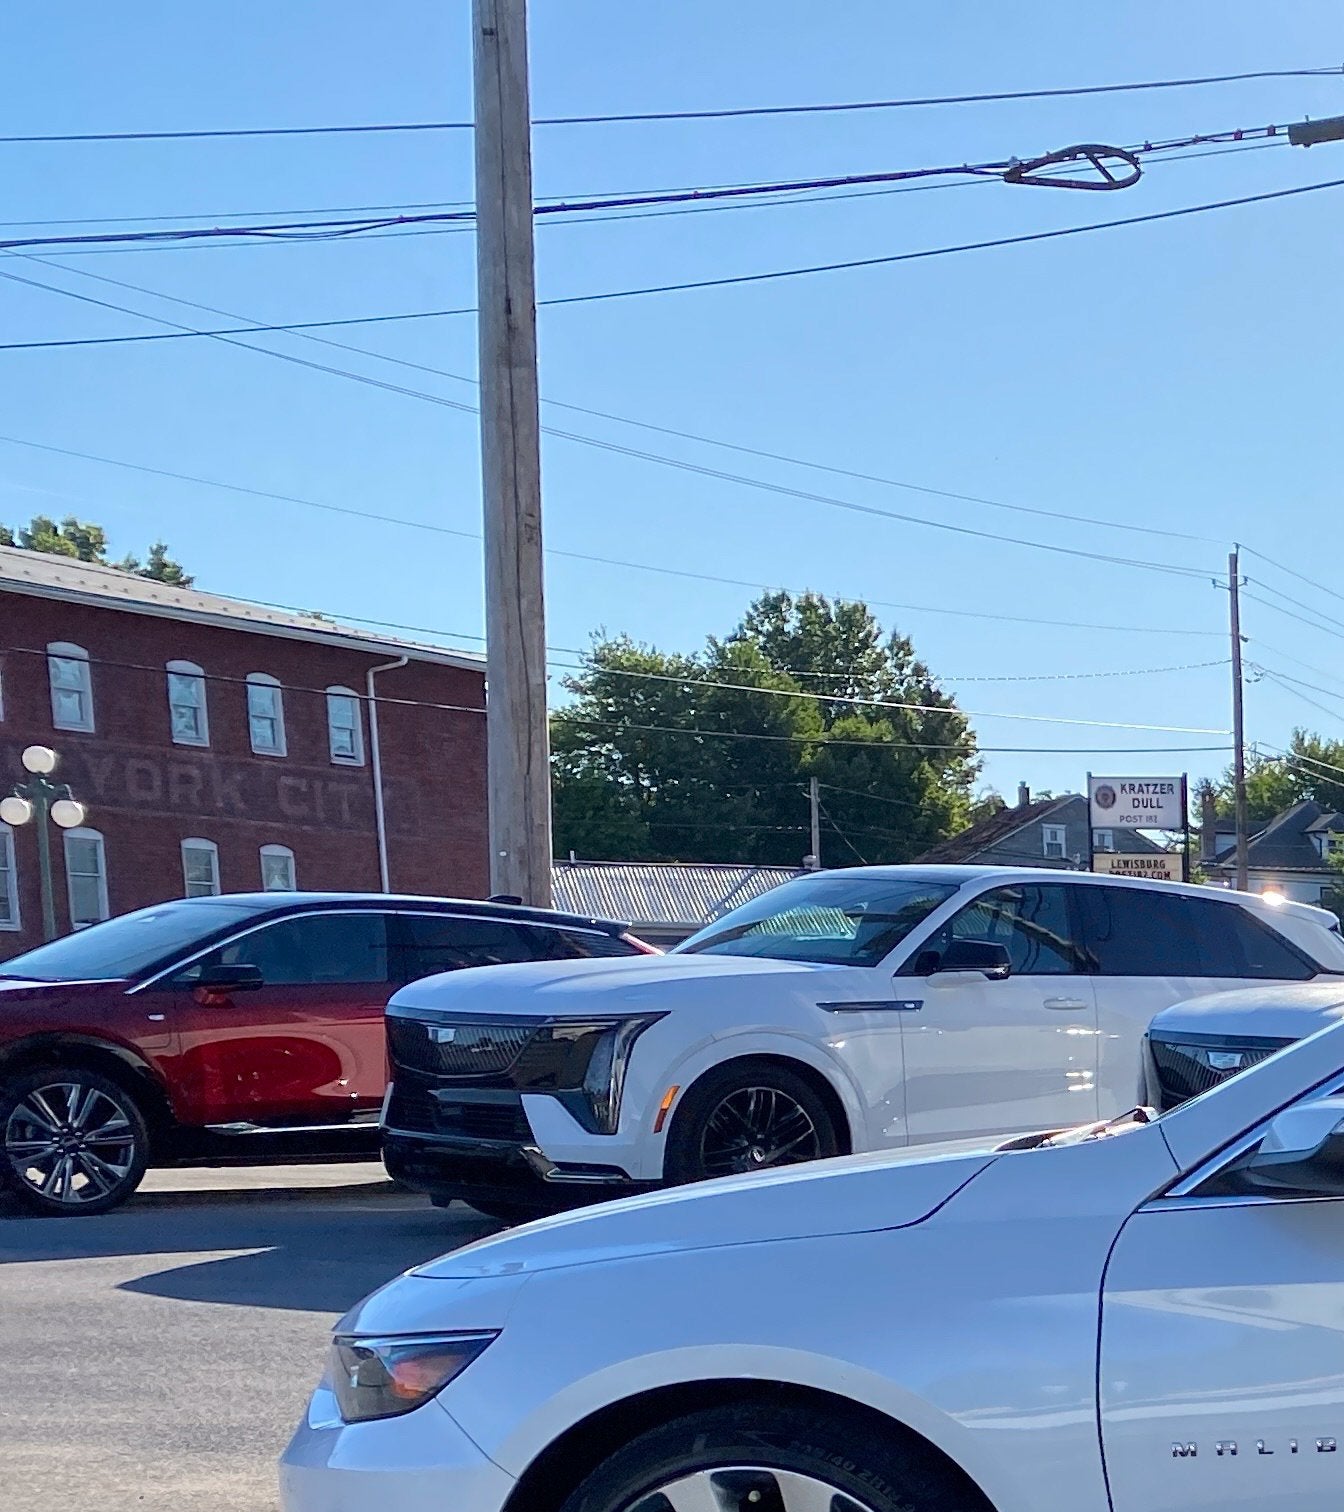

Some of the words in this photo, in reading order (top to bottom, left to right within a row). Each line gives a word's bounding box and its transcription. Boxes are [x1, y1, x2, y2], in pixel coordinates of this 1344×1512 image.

[82, 753, 249, 810] YORK
[1120, 784, 1174, 794] KRATZER
[1132, 798, 1163, 808] DULL
[1119, 815, 1143, 823] POST
[1146, 814, 1158, 823] 182
[1111, 860, 1165, 869] LEWISBURG
